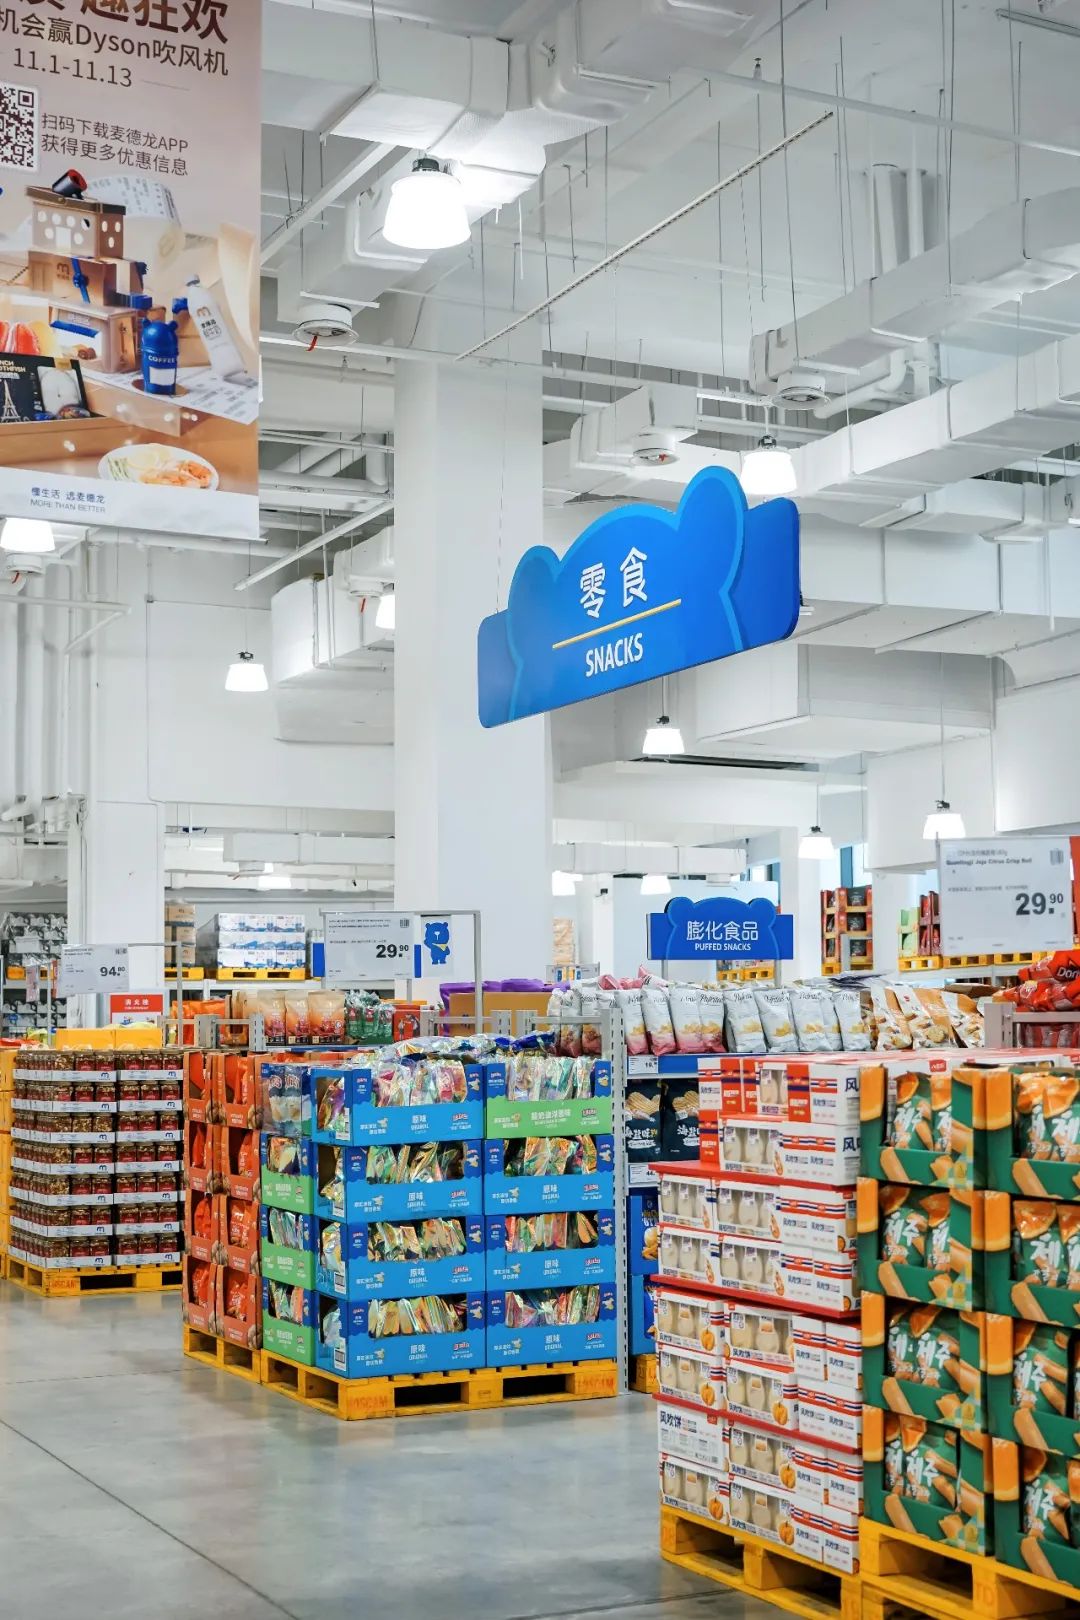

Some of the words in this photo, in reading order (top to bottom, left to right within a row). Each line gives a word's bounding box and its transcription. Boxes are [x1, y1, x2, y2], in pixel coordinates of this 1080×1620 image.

[13, 48, 132, 88] 11.1-11.13
[41, 112, 189, 154] 扫码下载麦德龙APP
[41, 133, 188, 177] 获得更多优惠信息
[148, 354, 176, 364] COFFEE
[30, 499, 52, 508] MORE
[55, 502, 76, 510] THAN
[77, 504, 106, 514] BETTER
[580, 546, 648, 619] 零食
[585, 632, 644, 678] SNACKS
[1015, 892, 1064, 916] 29.90
[686, 920, 759, 941] 膨化食品
[375, 944, 409, 959] 29.90
[694, 942, 722, 951] PUFFED
[723, 942, 752, 951] SNACKS
